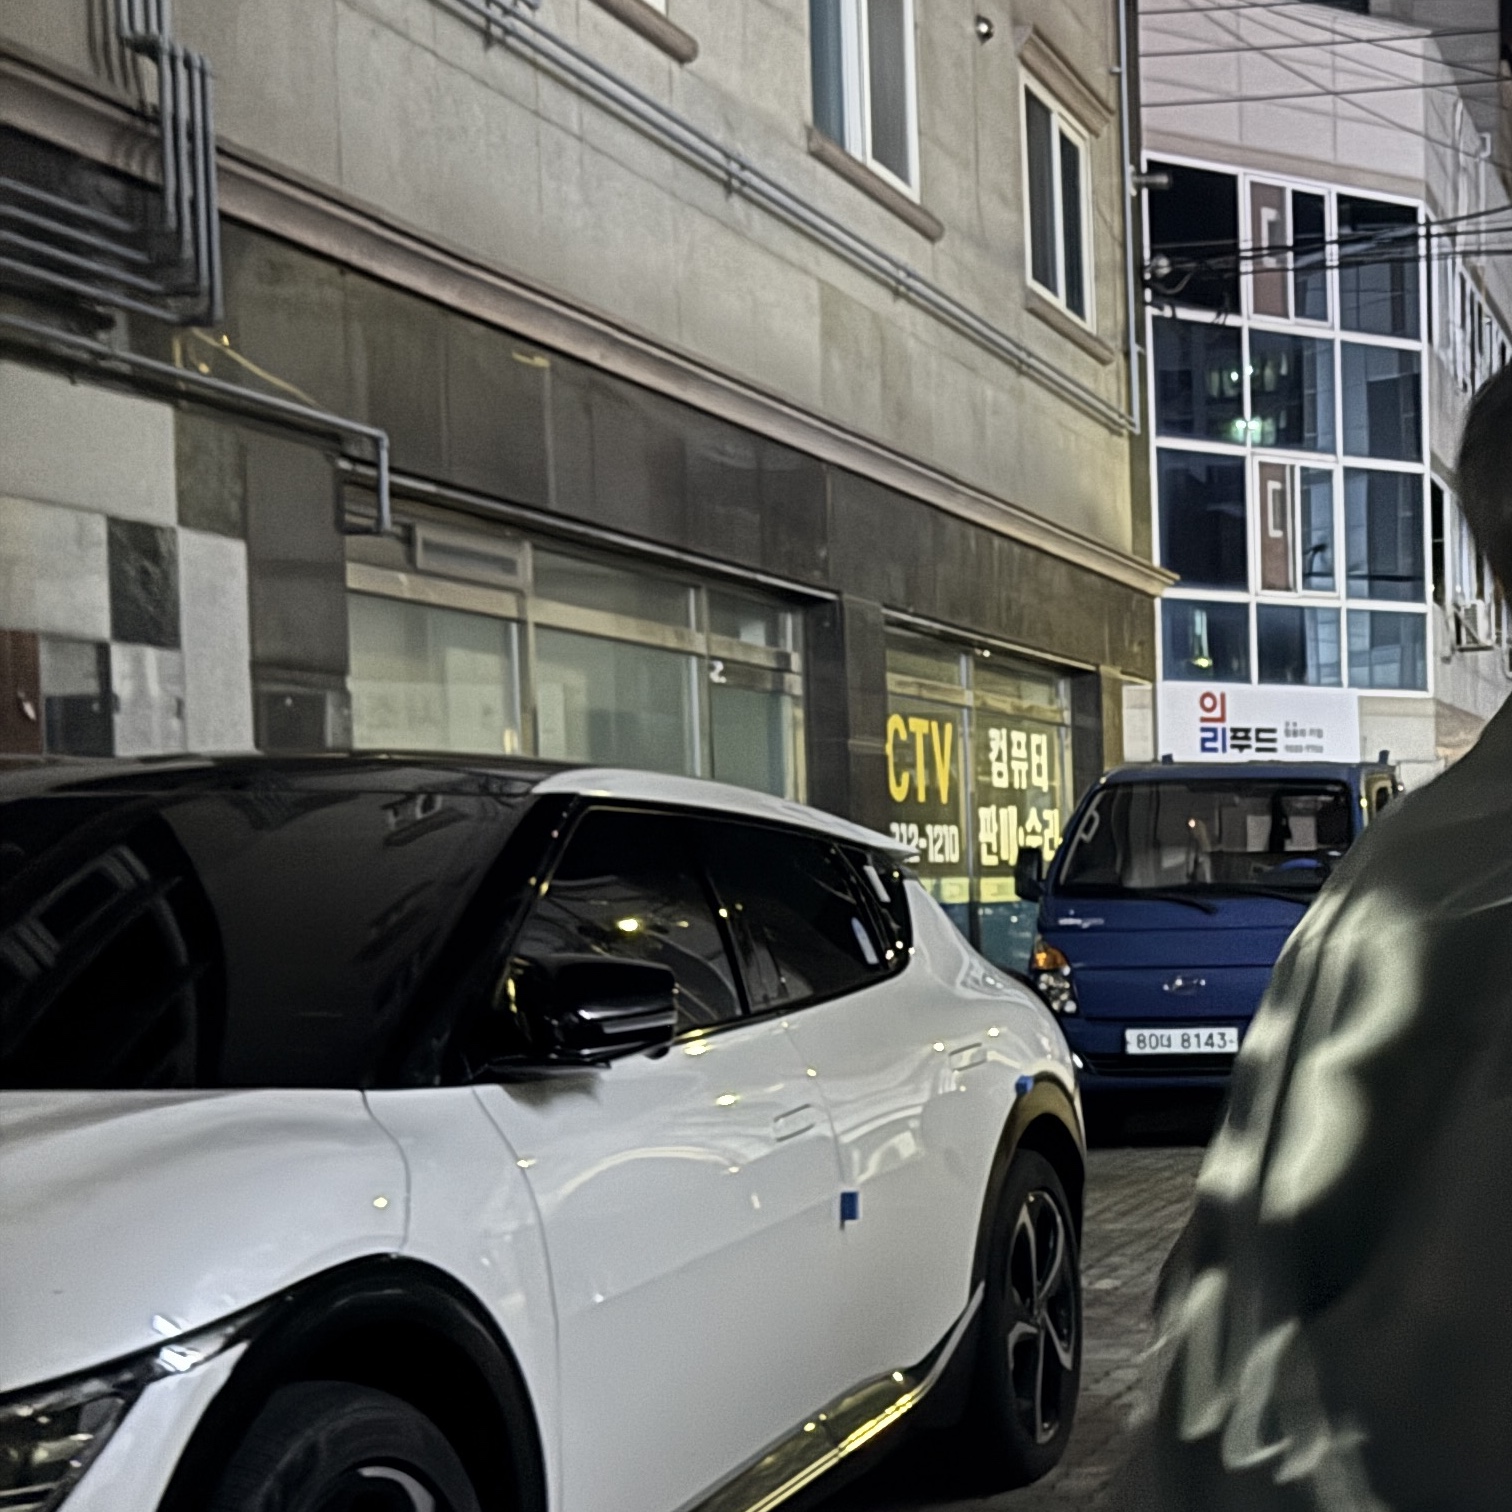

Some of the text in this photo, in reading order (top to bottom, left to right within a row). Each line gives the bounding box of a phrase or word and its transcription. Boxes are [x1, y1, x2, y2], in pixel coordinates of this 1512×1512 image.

[1199, 691, 1226, 723] 의
[1200, 727, 1278, 753] 리푸드
[988, 727, 1049, 793] 컴퓨터
[1180, 1031, 1228, 1050] 8143
